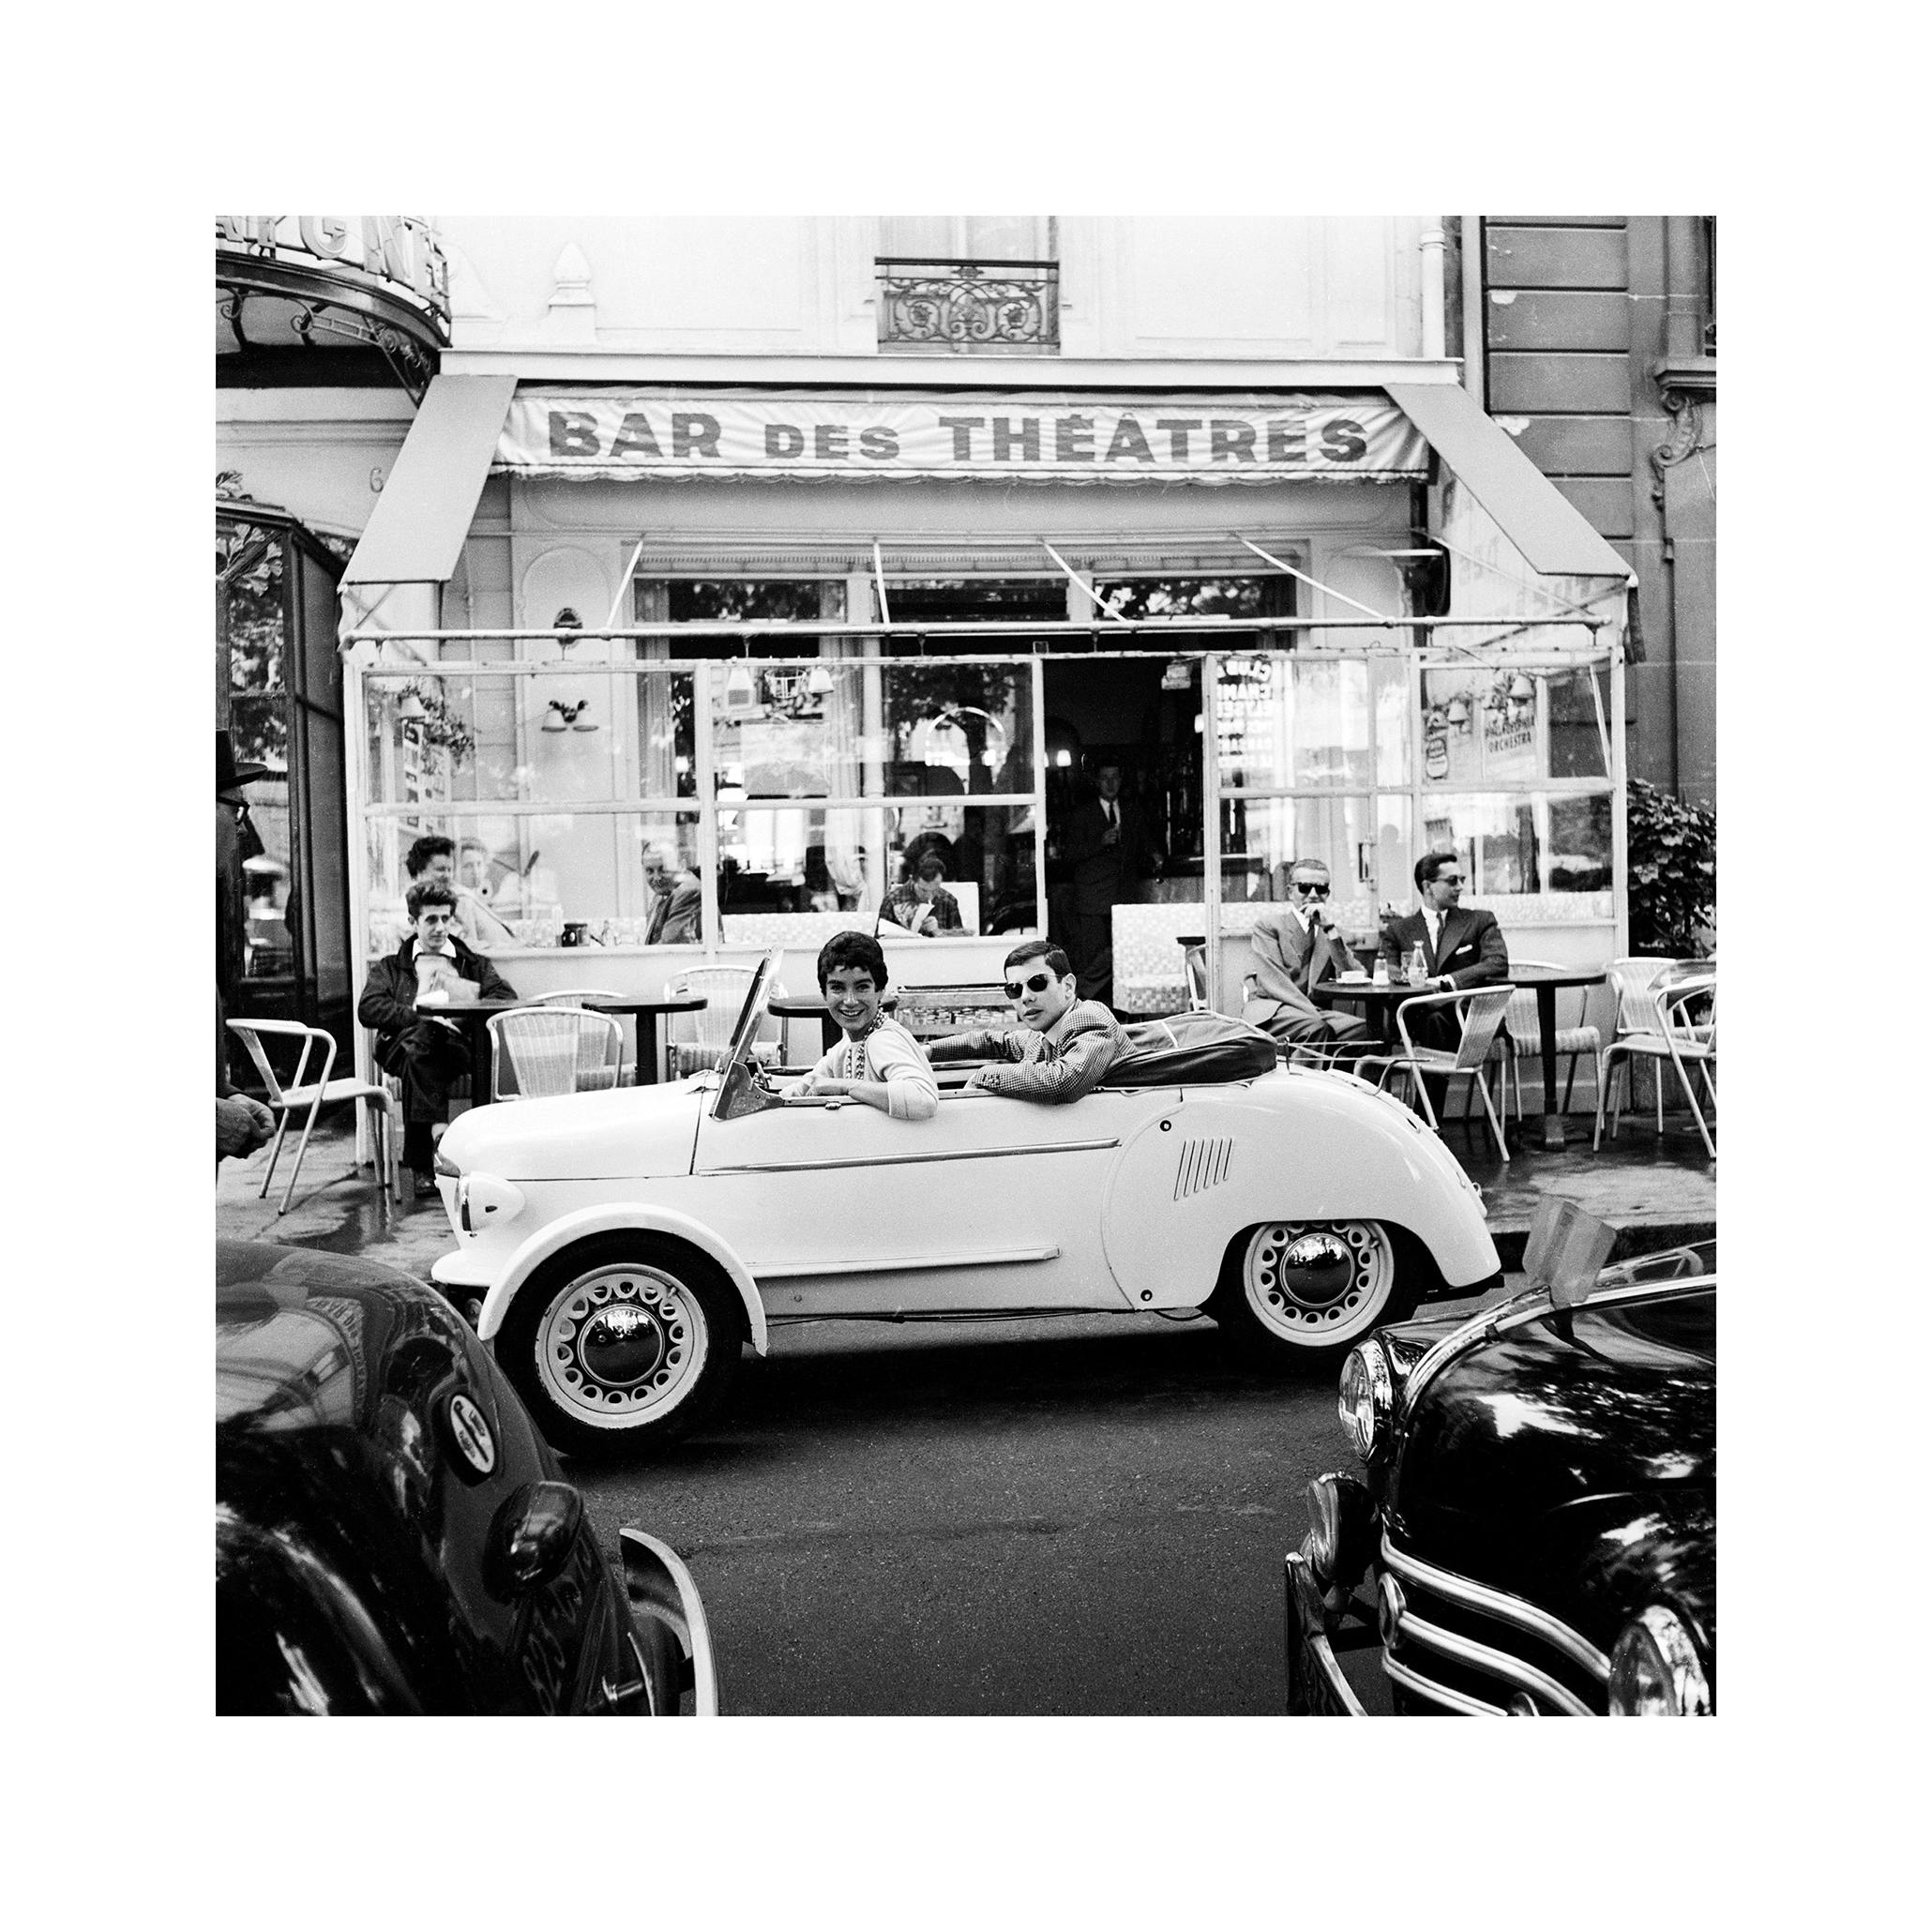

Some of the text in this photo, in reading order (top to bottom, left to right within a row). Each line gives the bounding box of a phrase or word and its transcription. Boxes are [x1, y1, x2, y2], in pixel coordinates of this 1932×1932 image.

[548, 411, 1368, 463] BAR DES THÉÂTRES
[370, 467, 385, 493] 6
